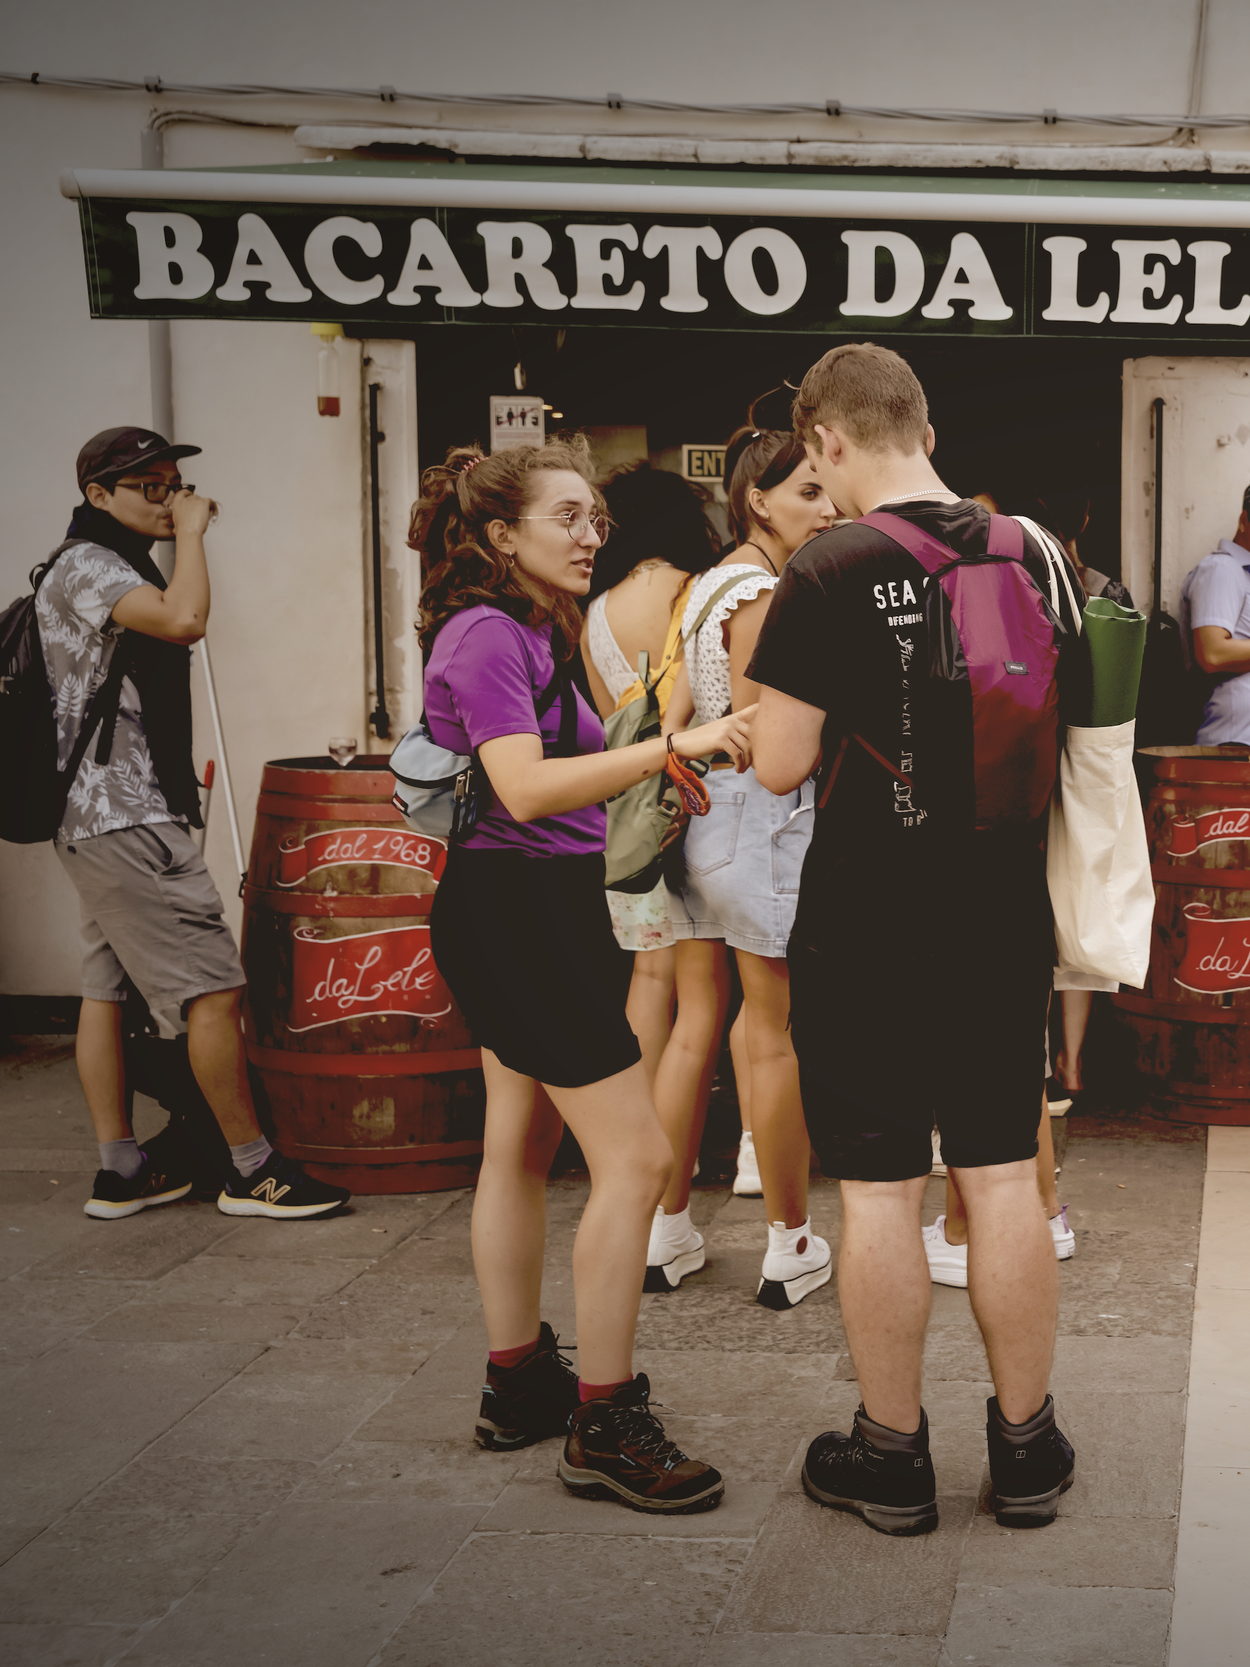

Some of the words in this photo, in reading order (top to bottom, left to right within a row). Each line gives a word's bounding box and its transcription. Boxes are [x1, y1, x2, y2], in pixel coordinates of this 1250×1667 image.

[126, 211, 807, 315] BACARETO
[839, 230, 1013, 321] DA
[873, 579, 917, 609] SEA
[1204, 813, 1249, 837] dal
[318, 833, 367, 861] dal
[372, 834, 431, 865] 1968
